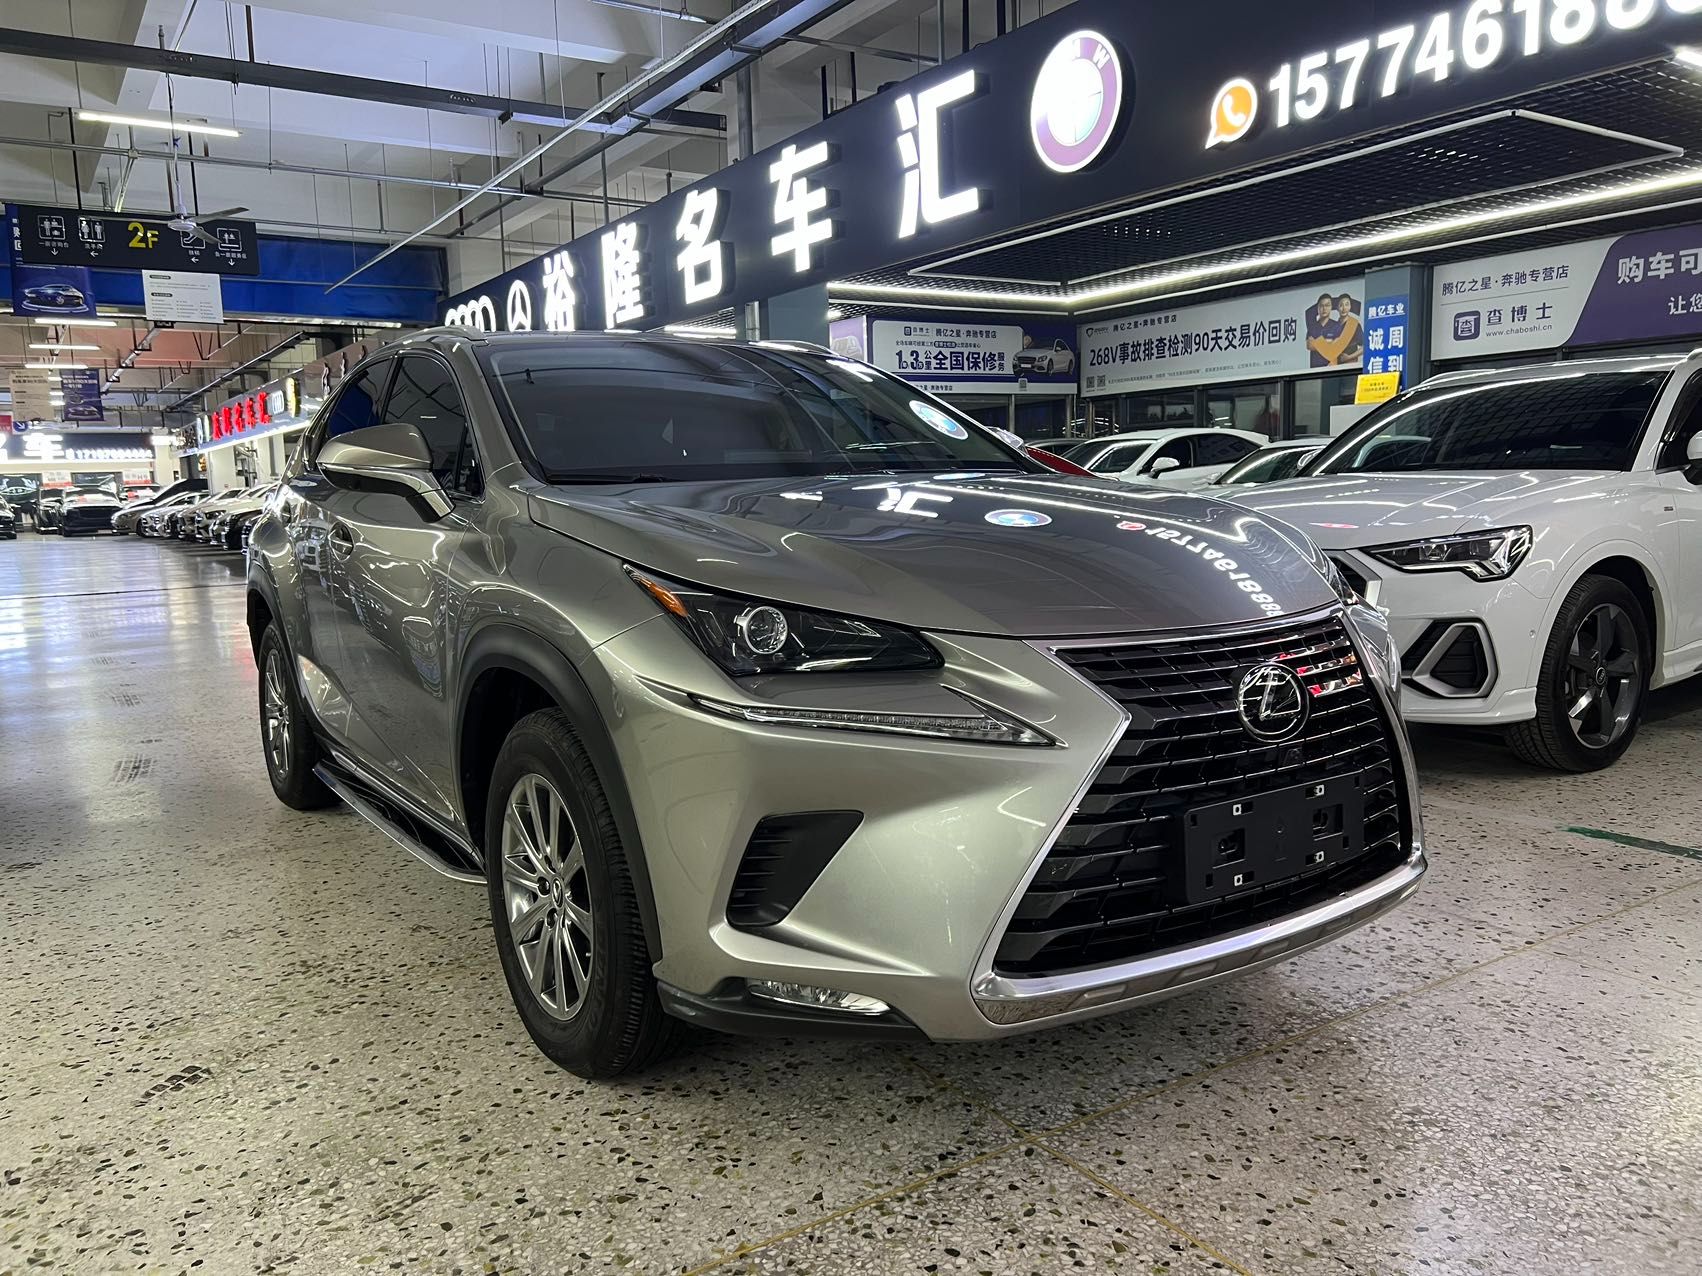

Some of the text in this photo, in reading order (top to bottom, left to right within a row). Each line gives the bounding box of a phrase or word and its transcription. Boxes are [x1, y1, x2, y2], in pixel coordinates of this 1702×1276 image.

[127, 221, 160, 249] 2F
[1441, 264, 1570, 297] 腾亿之星·奔驰专营店
[1089, 316, 1297, 368] 268V事故排查检测90天交易价回购
[1485, 324, 1553, 338] www.chaboshi.cn
